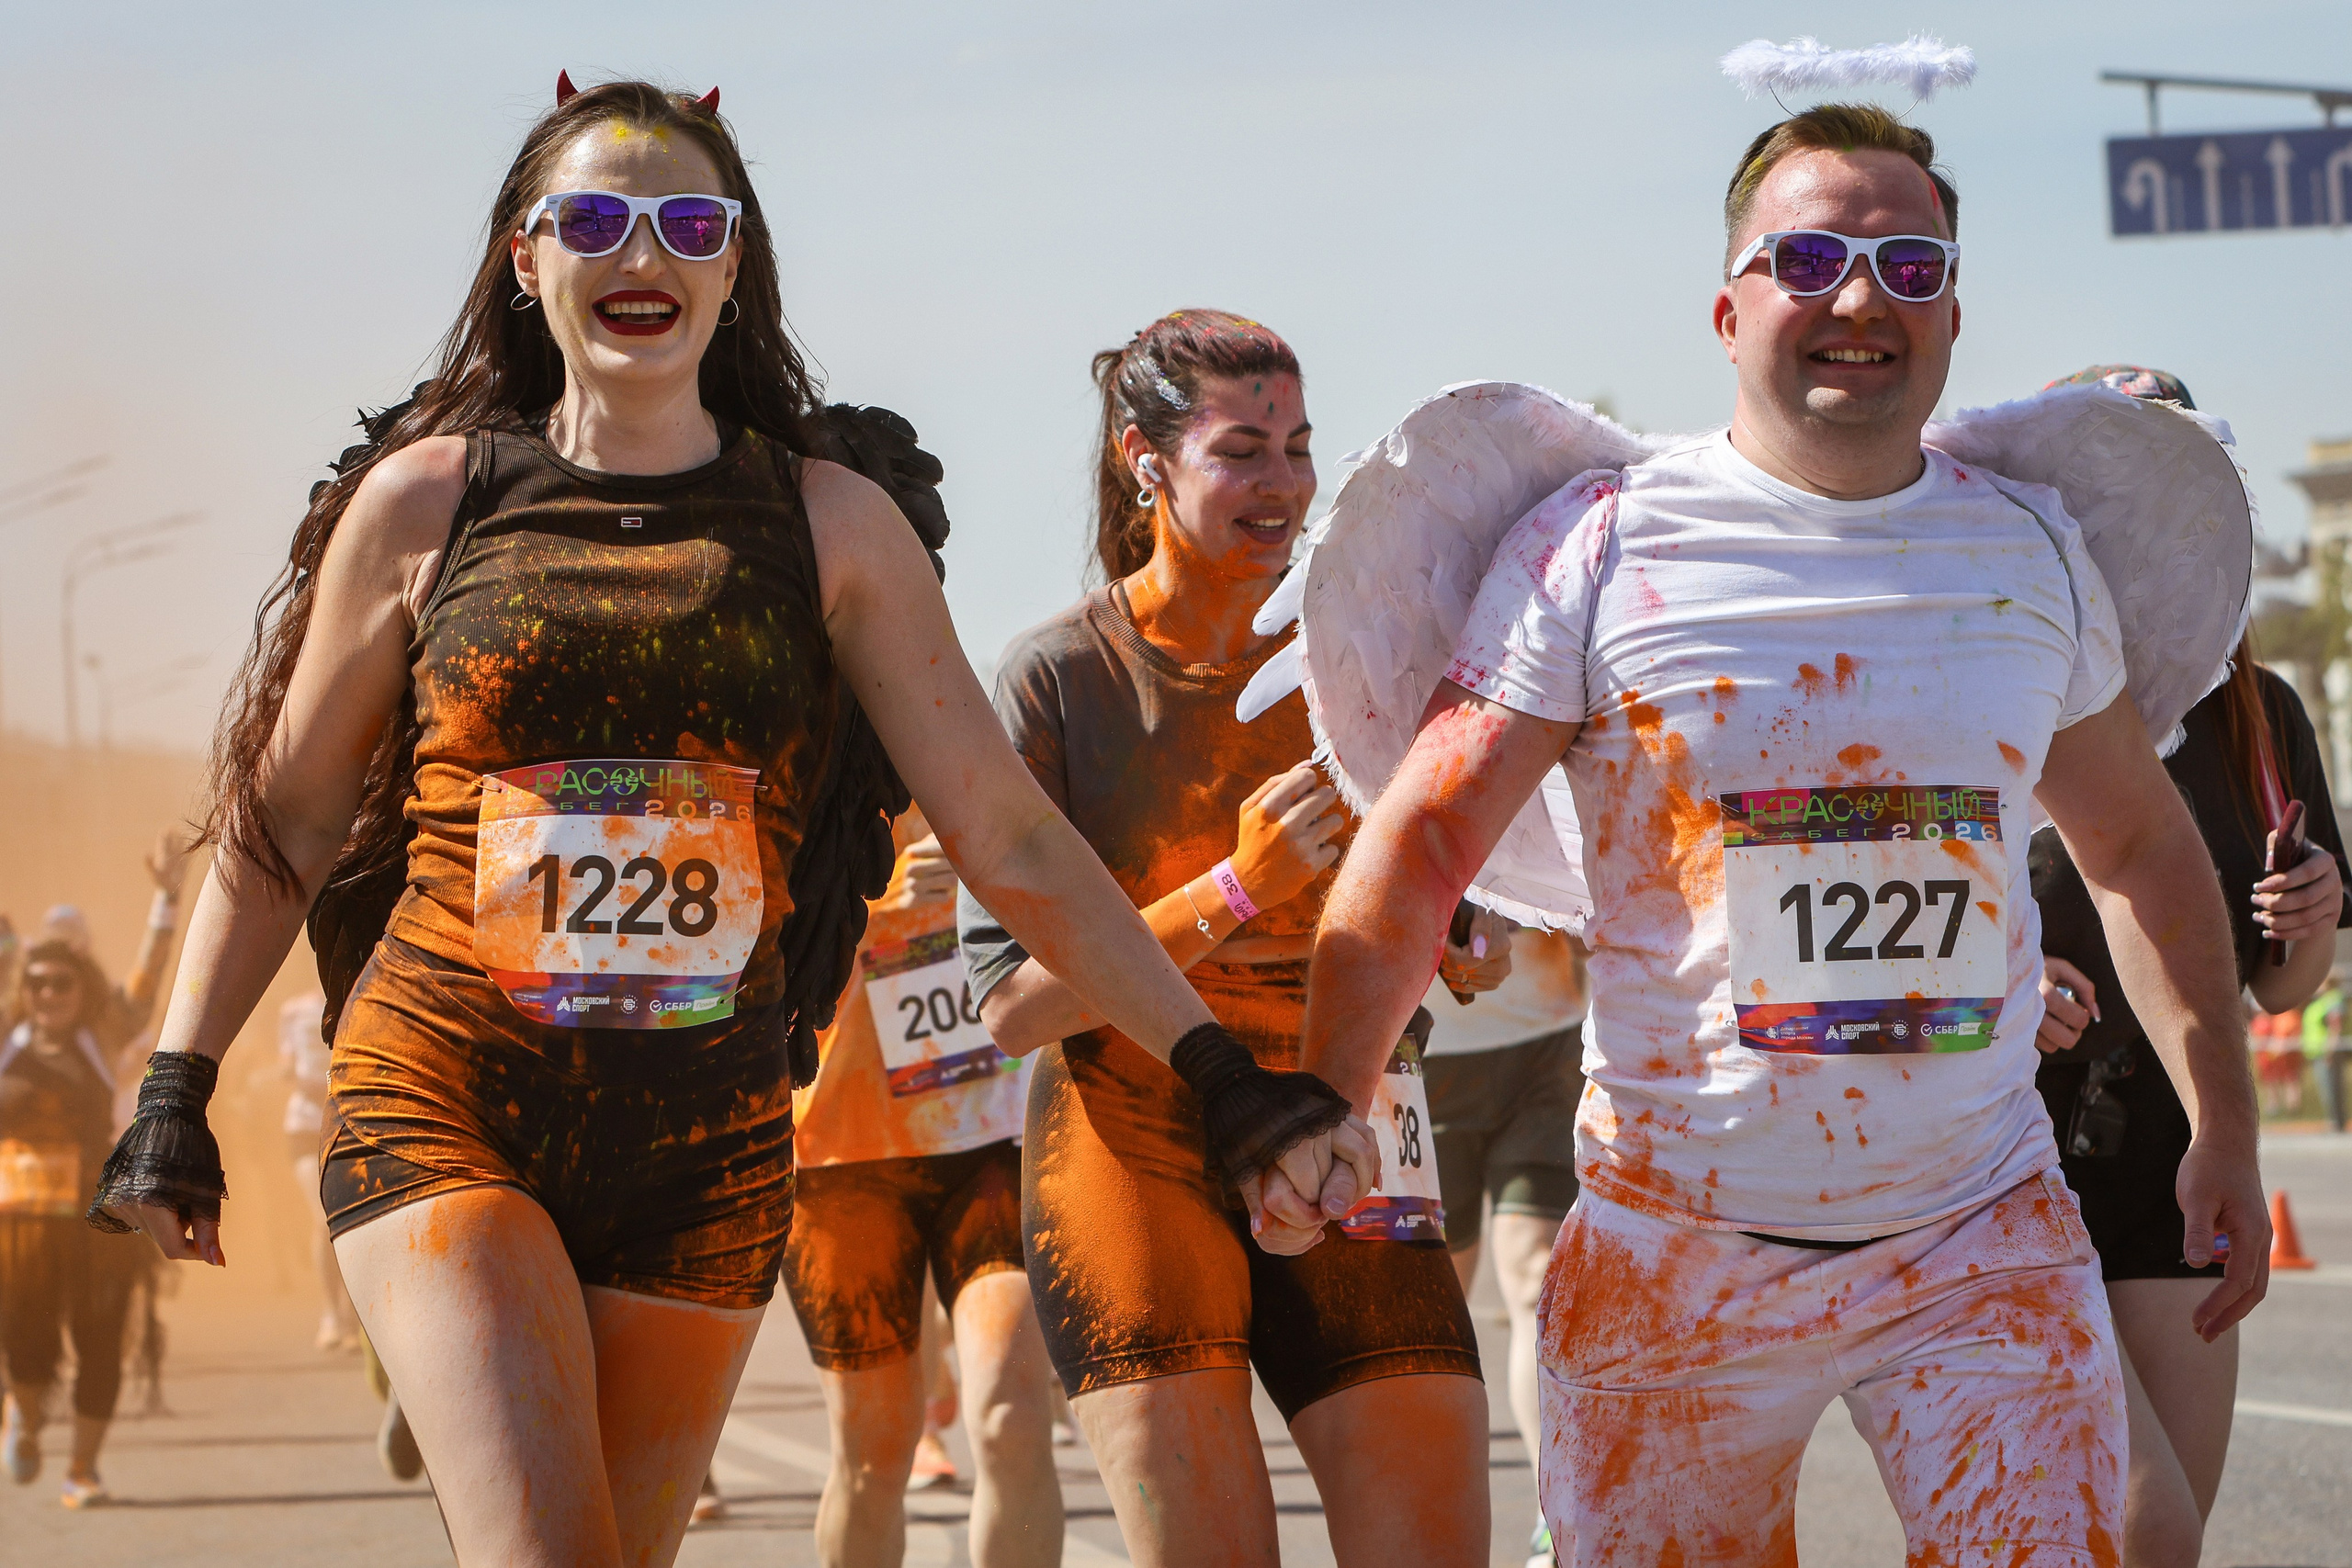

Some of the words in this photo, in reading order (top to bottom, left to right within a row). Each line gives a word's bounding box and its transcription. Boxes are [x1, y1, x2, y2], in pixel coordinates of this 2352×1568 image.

[645, 799, 752, 821] 2026
[1748, 788, 1981, 826] КРАСОЧНЫЙ
[1750, 828, 1876, 841] ЗАБЕГ
[1891, 823, 1998, 842] 2026
[1221, 874, 1238, 896] 38
[528, 854, 719, 938] 1228
[1779, 880, 1970, 963] 1227
[572, 995, 610, 1005] МОСКОВСКИЙ
[572, 1004, 591, 1012] СПОРТ
[664, 1001, 692, 1010] СБЕР
[1840, 1021, 1881, 1032] МОСКОВСКИЙ
[1841, 1032, 1860, 1040] СПОРТ
[1934, 1025, 1958, 1034] СБЕР
[1393, 1103, 1422, 1169] 38
